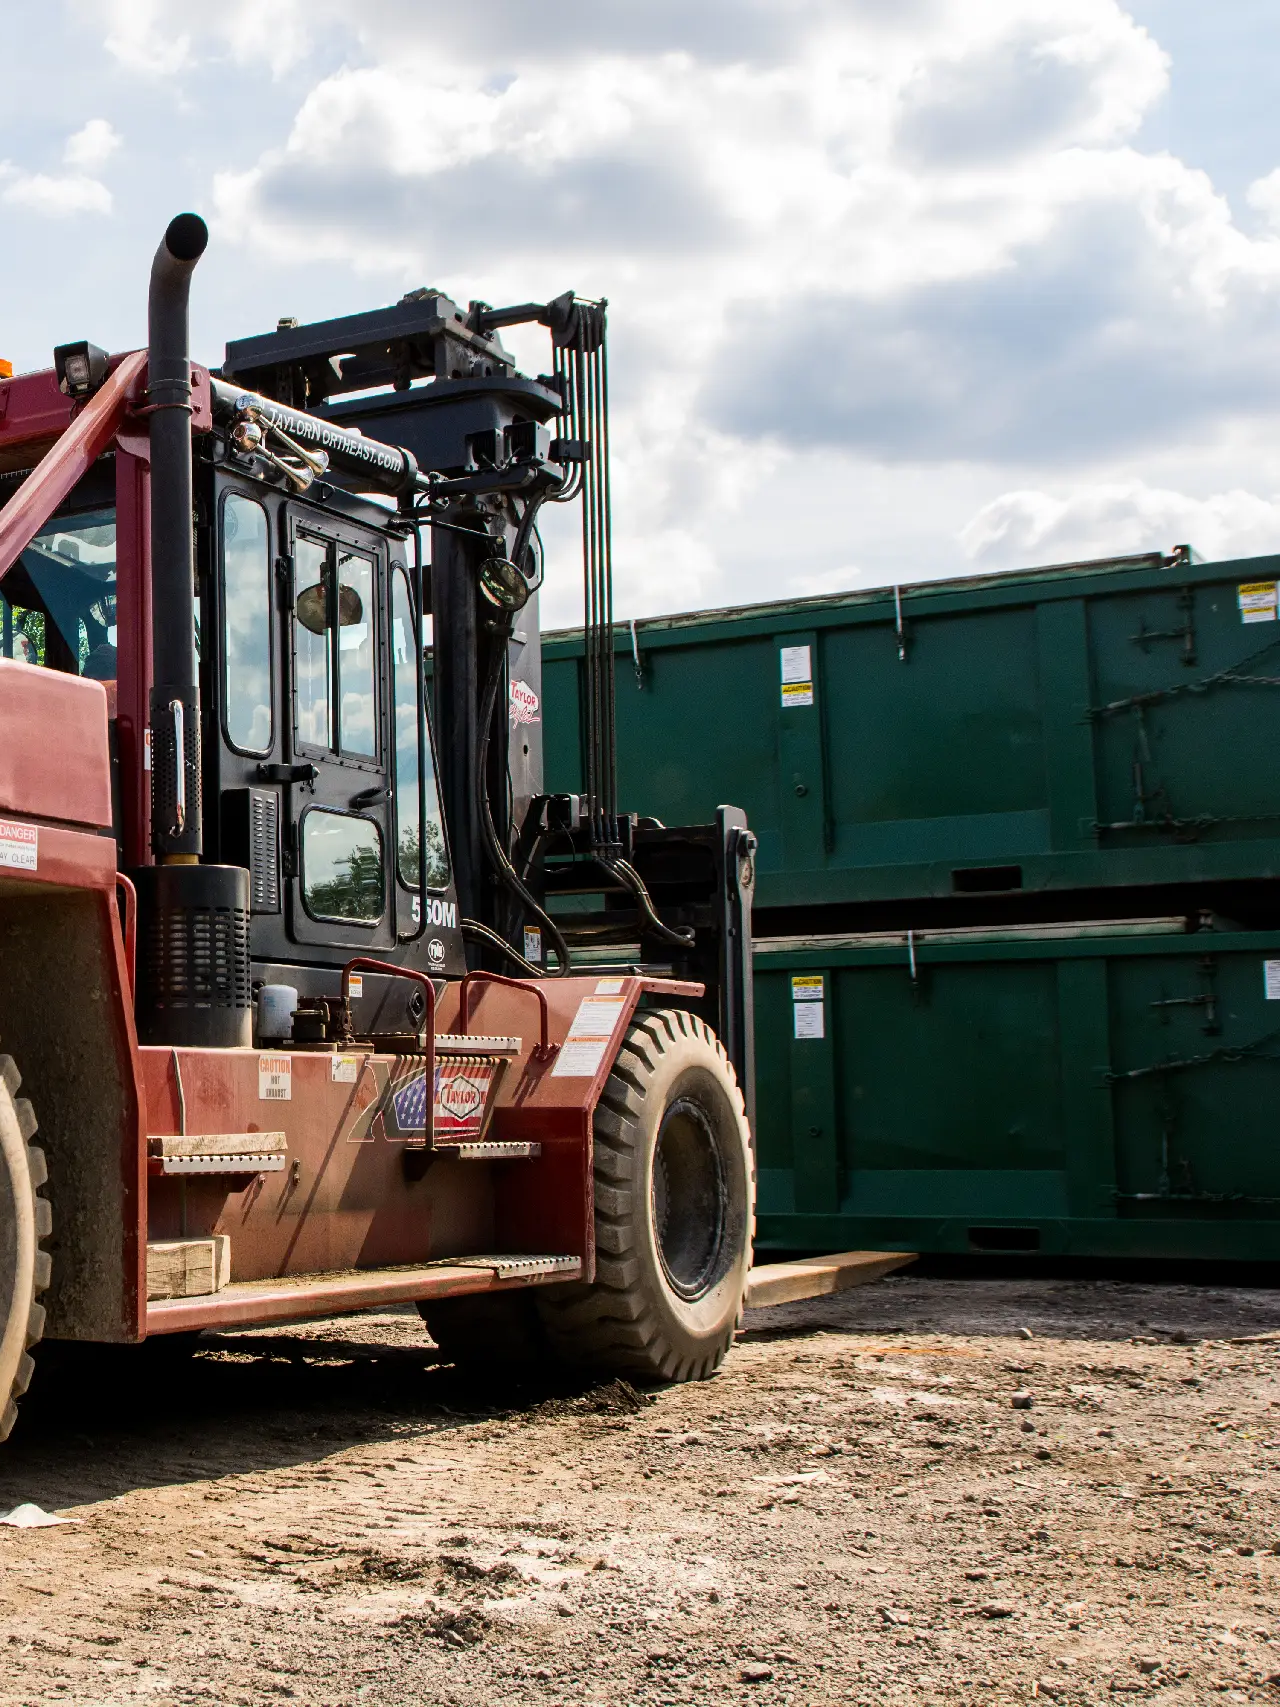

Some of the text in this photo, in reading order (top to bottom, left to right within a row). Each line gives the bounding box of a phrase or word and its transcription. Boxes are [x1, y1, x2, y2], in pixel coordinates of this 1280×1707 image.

[511, 681, 535, 706] TAYLOR
[0, 824, 36, 841] DANGER
[11, 853, 35, 866] CLEAR
[260, 1058, 291, 1073] CAUTION
[266, 1088, 287, 1098] EXHAUST
[444, 1083, 476, 1104] TAYLOR
